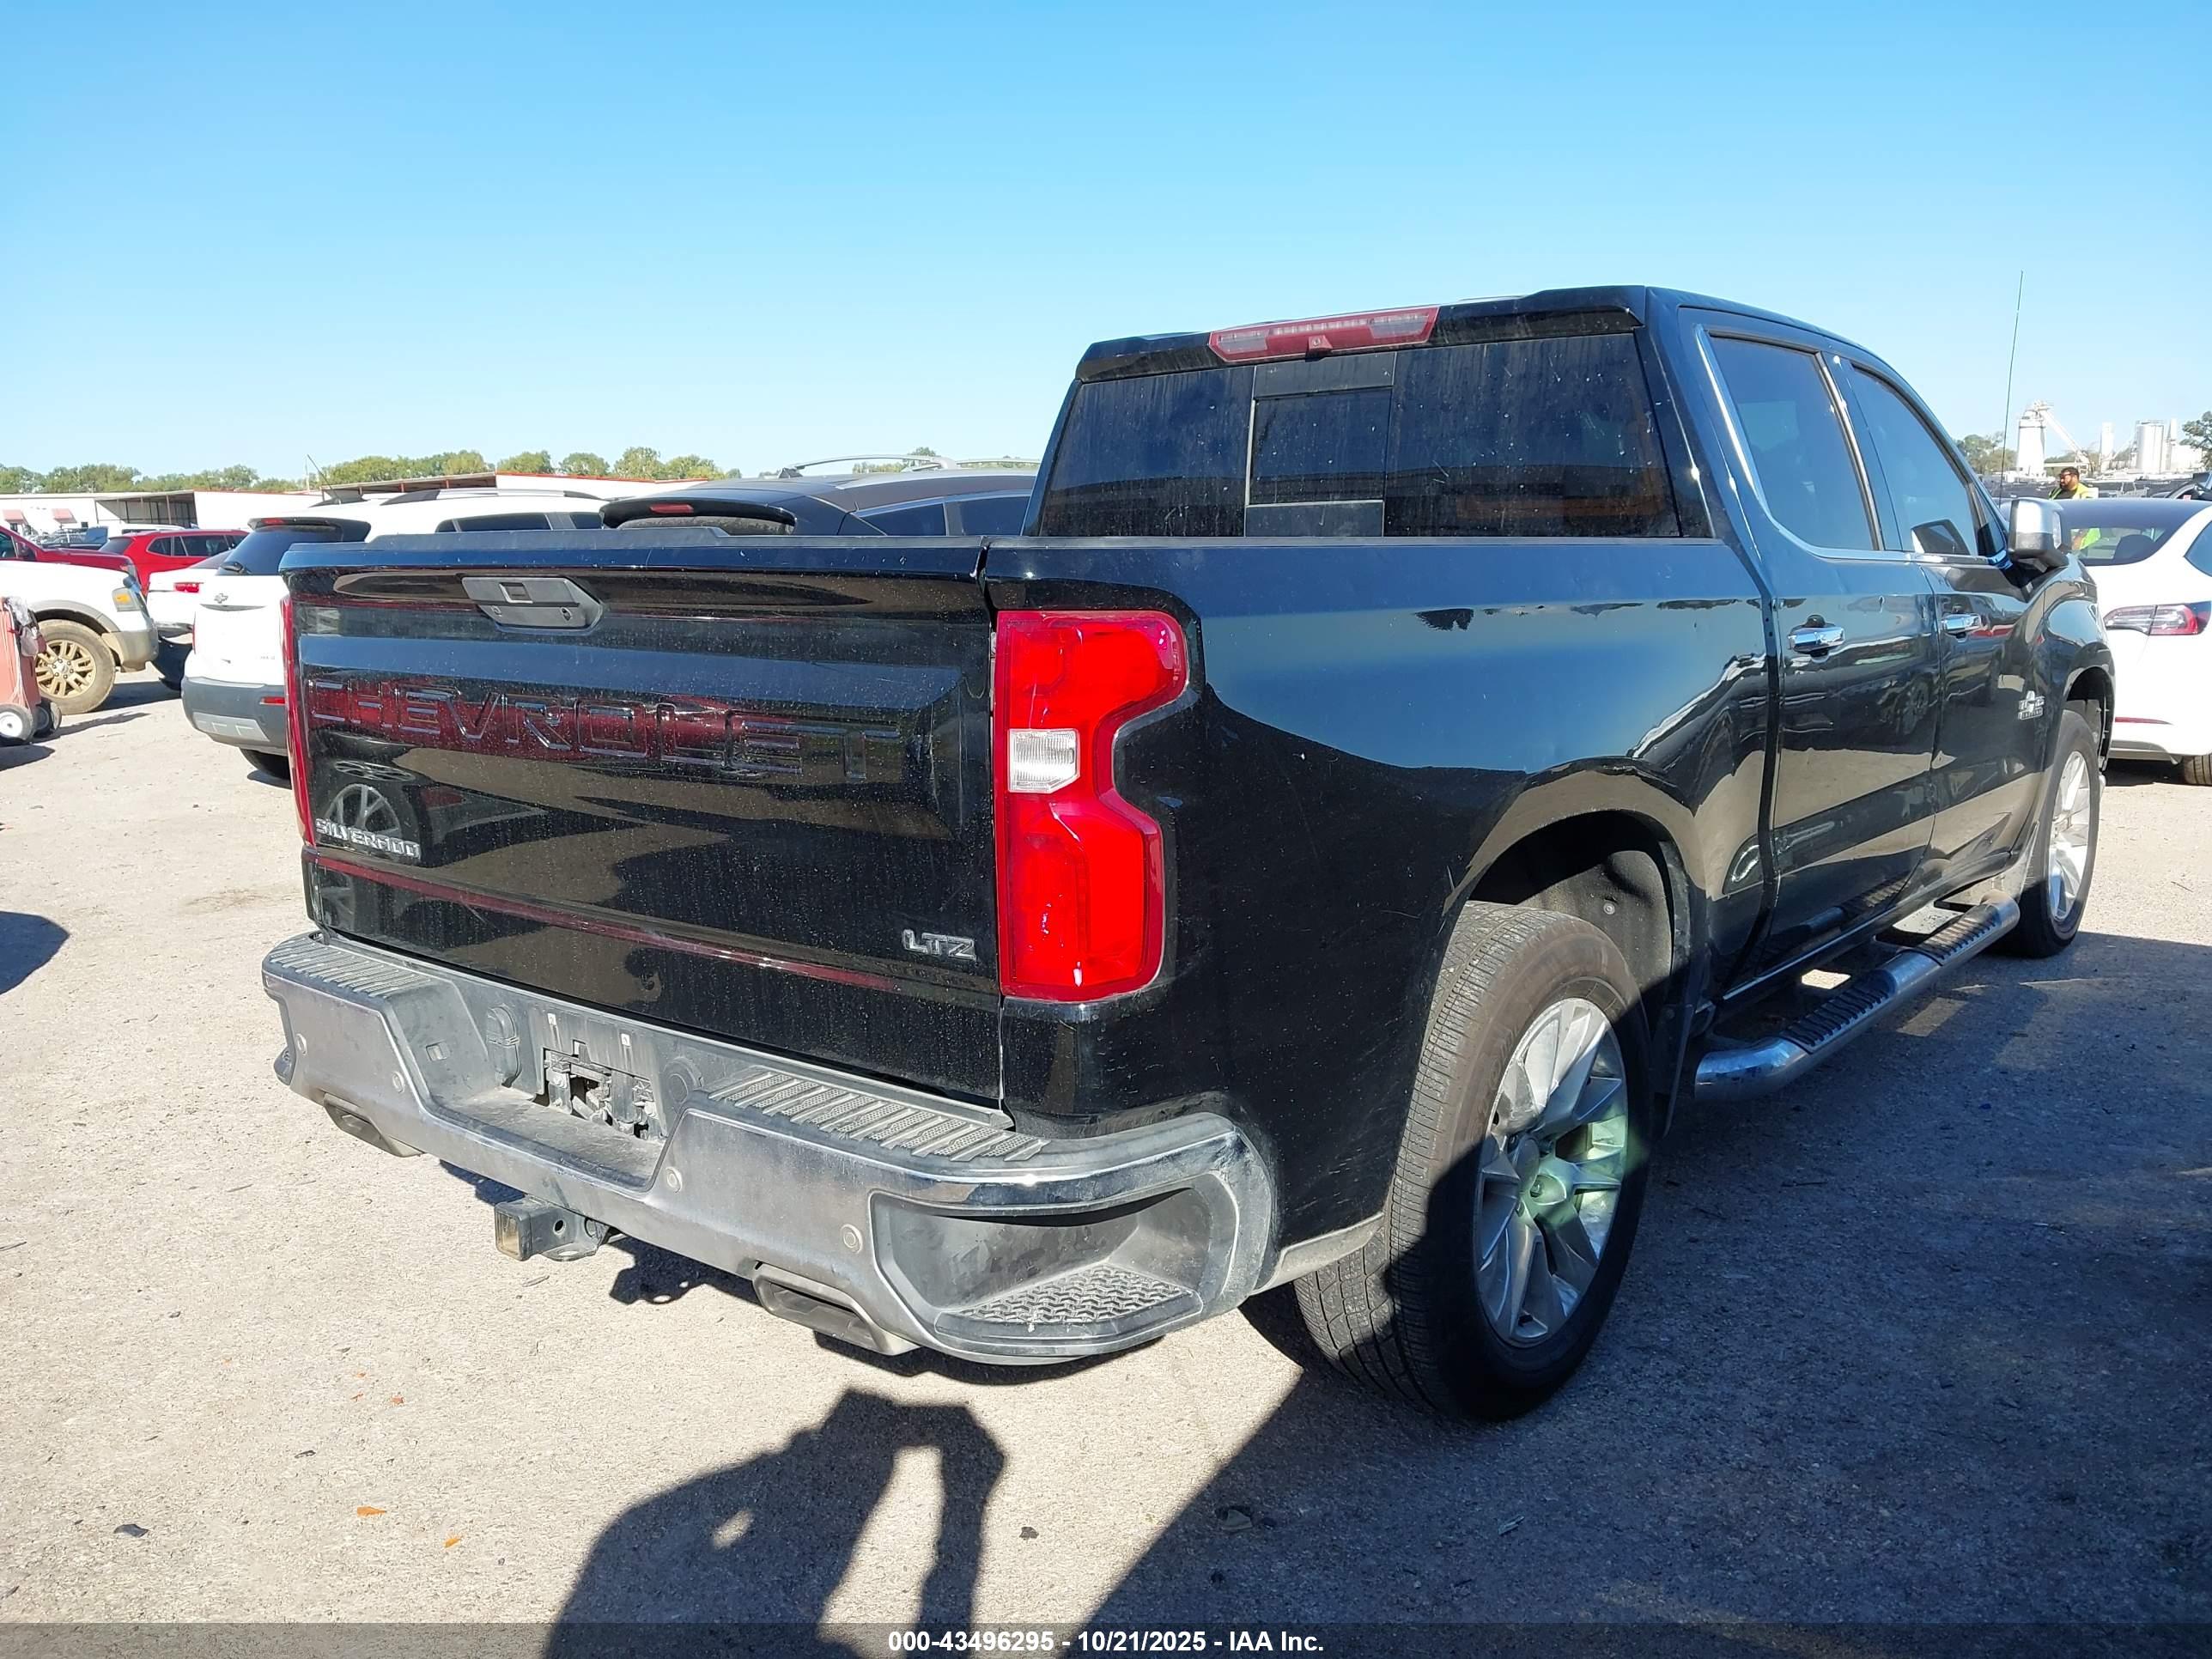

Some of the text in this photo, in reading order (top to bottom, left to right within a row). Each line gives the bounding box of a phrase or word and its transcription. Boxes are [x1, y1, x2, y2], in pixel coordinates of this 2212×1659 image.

[307, 678, 902, 780] CHEVROLET
[315, 817, 421, 860] SILVERADO
[902, 929, 976, 961] LTZ
